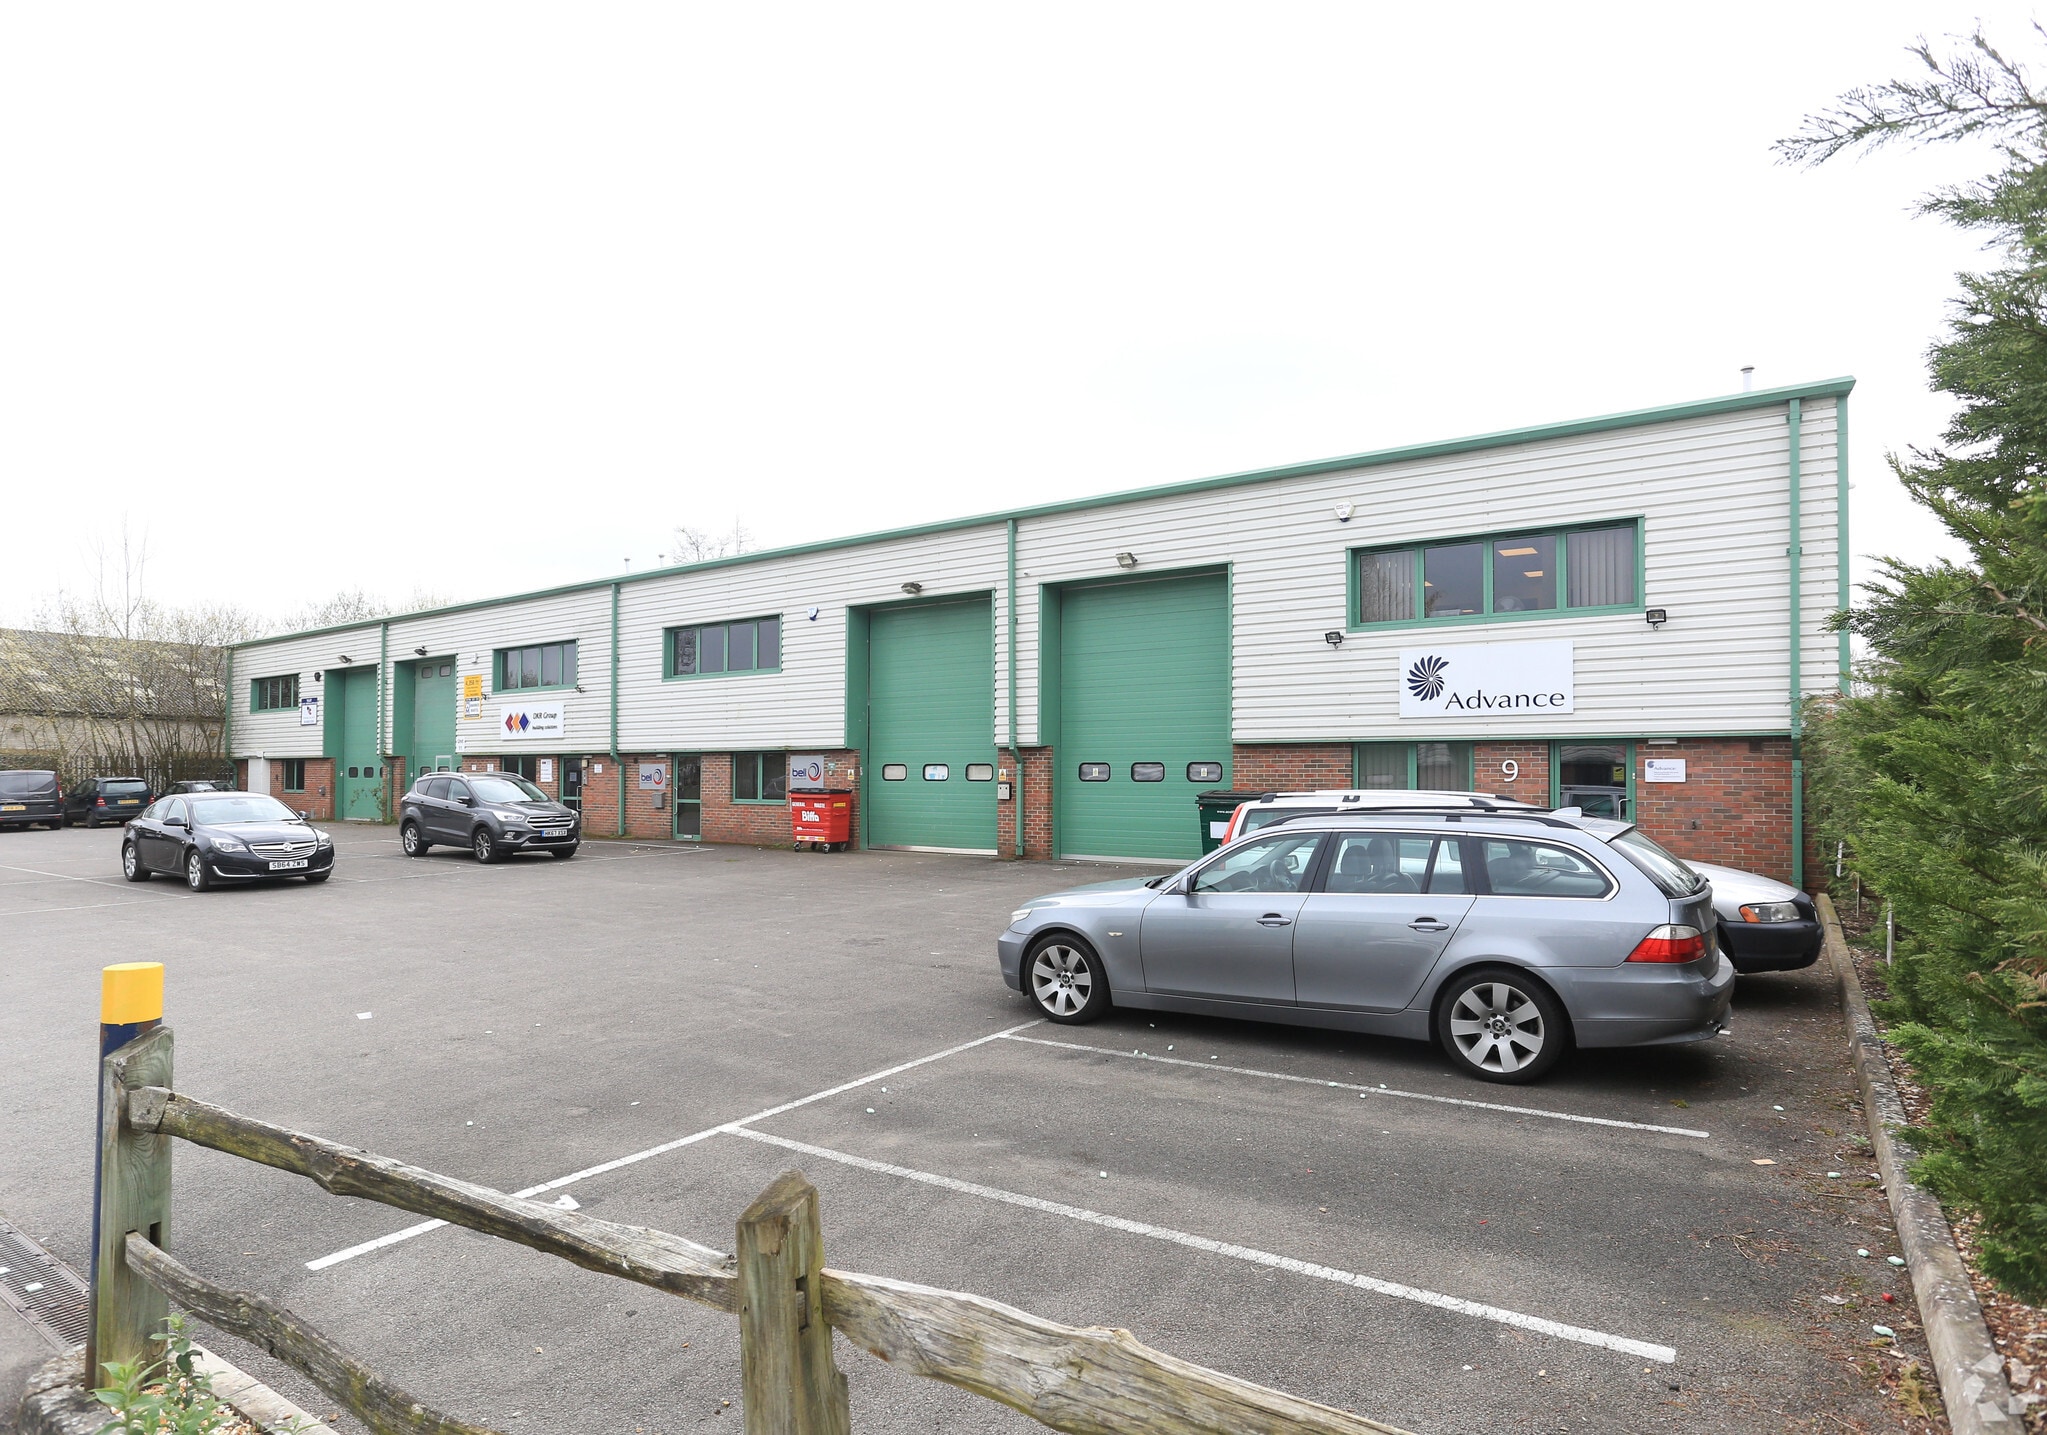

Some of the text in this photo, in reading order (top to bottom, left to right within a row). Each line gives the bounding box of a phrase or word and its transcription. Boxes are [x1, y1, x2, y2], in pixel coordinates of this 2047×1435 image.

[1445, 689, 1565, 710] Advance
[793, 768, 807, 777] bell
[1501, 759, 1519, 782] 9
[641, 773, 652, 781] bell
[801, 810, 820, 822] Biffa
